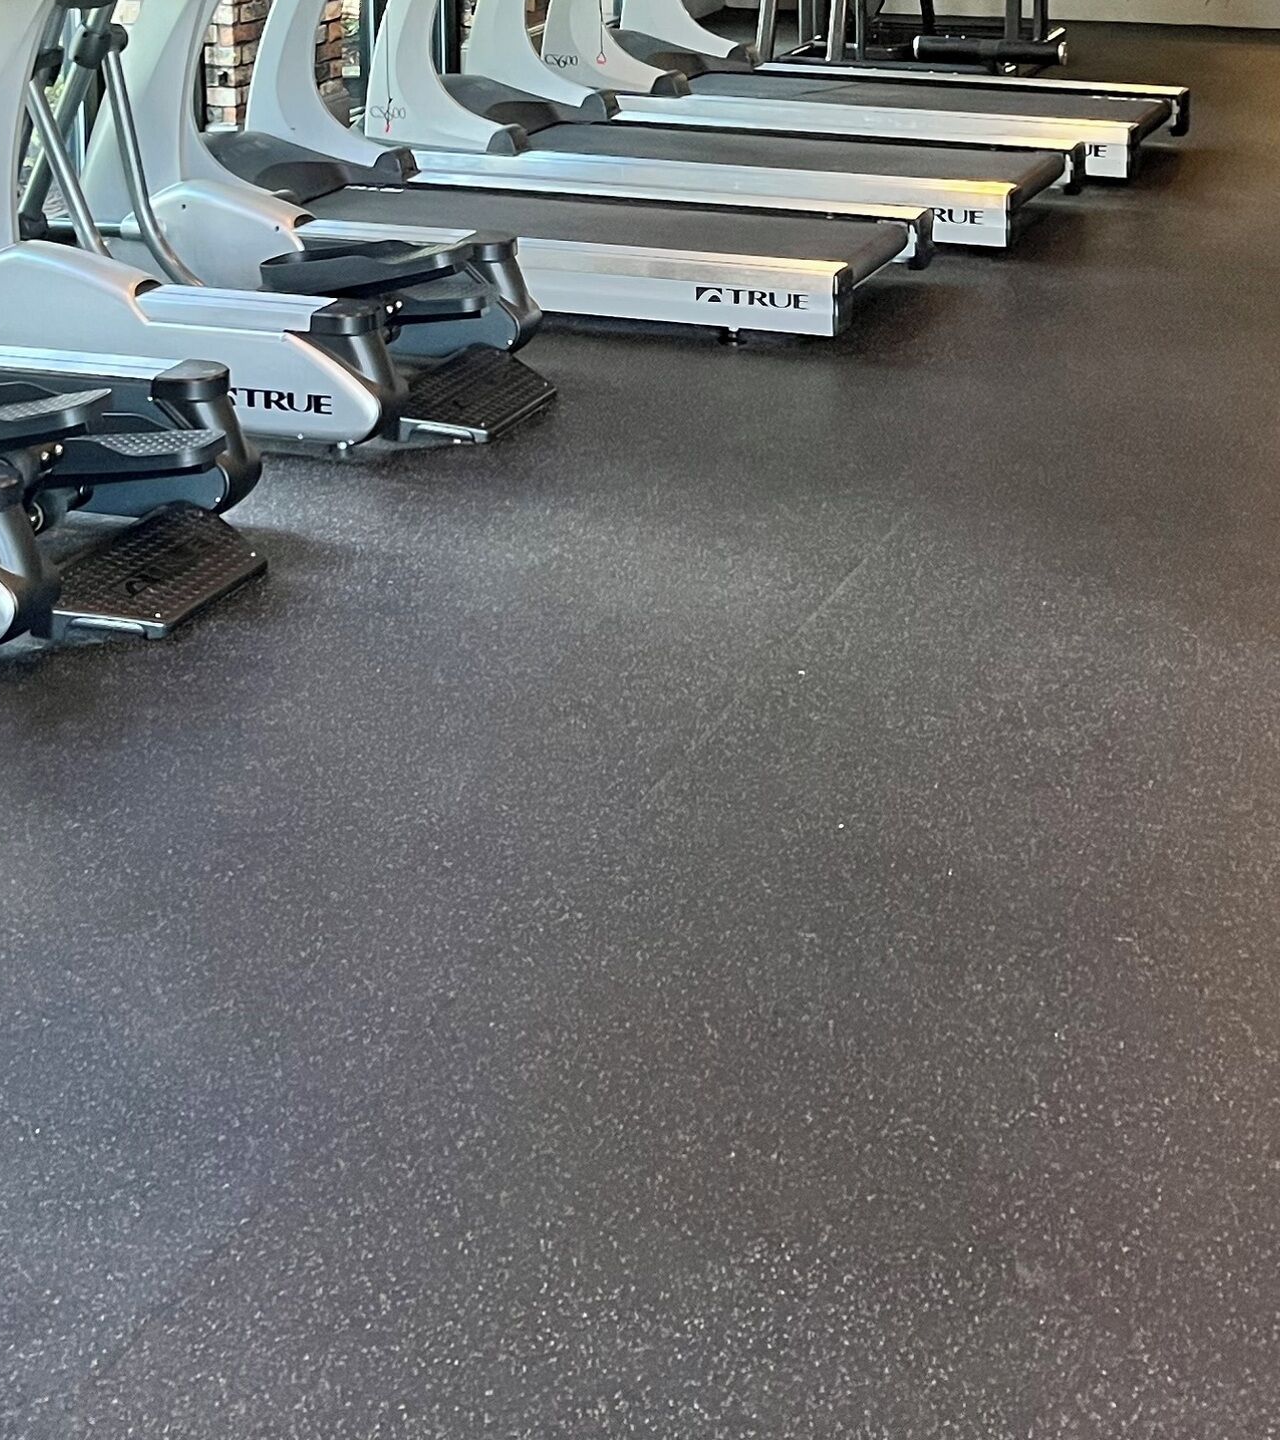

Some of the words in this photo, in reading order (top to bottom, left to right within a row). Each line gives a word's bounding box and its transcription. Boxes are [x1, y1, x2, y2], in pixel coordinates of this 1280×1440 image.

[931, 207, 984, 225] RUE
[725, 288, 809, 311] TRUE
[237, 387, 333, 415] TRUE
